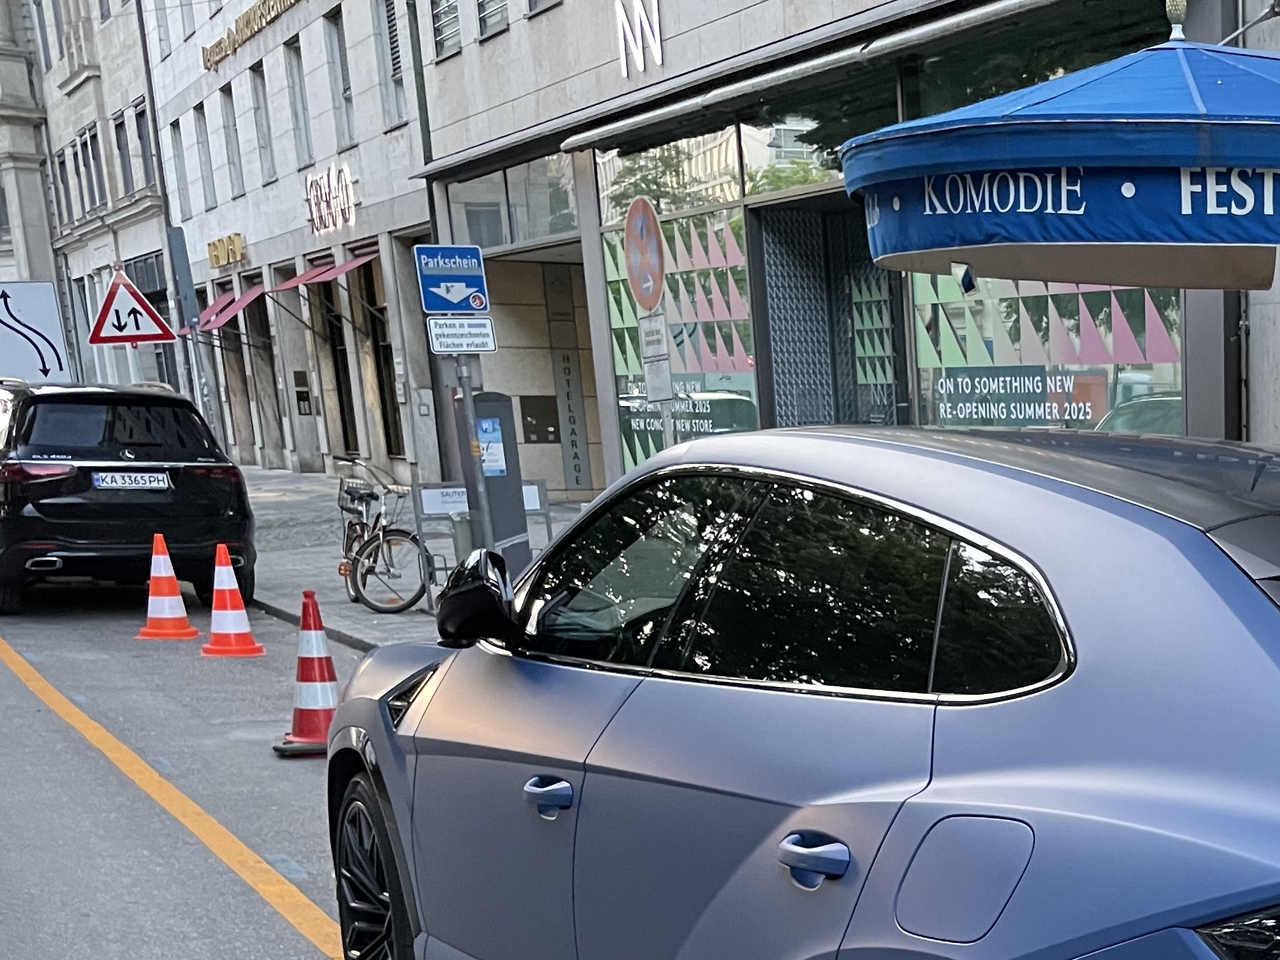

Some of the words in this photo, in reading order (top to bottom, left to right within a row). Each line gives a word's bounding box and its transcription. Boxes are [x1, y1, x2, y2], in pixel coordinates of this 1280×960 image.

[420, 253, 479, 269] Parkschein
[434, 321, 457, 329] Parken
[434, 331, 491, 341] gekennzeichneten
[439, 341, 464, 349] Flächen
[466, 341, 489, 349] erlaubt
[938, 378, 954, 394] ON
[957, 378, 972, 394] TO
[974, 376, 1042, 394] SOMETHING
[1046, 375, 1075, 393] NEW
[671, 400, 694, 413] UMMER
[695, 401, 711, 413] 2025
[939, 402, 1007, 419] RE-OPENING
[1010, 402, 1060, 420] SUMMER
[1064, 402, 1092, 420] 2025
[631, 418, 645, 431] NEW
[676, 420, 691, 432] NEW
[692, 419, 714, 432] STORE
[100, 475, 118, 485] KA
[119, 475, 147, 486] 3365
[148, 475, 166, 486] PH
